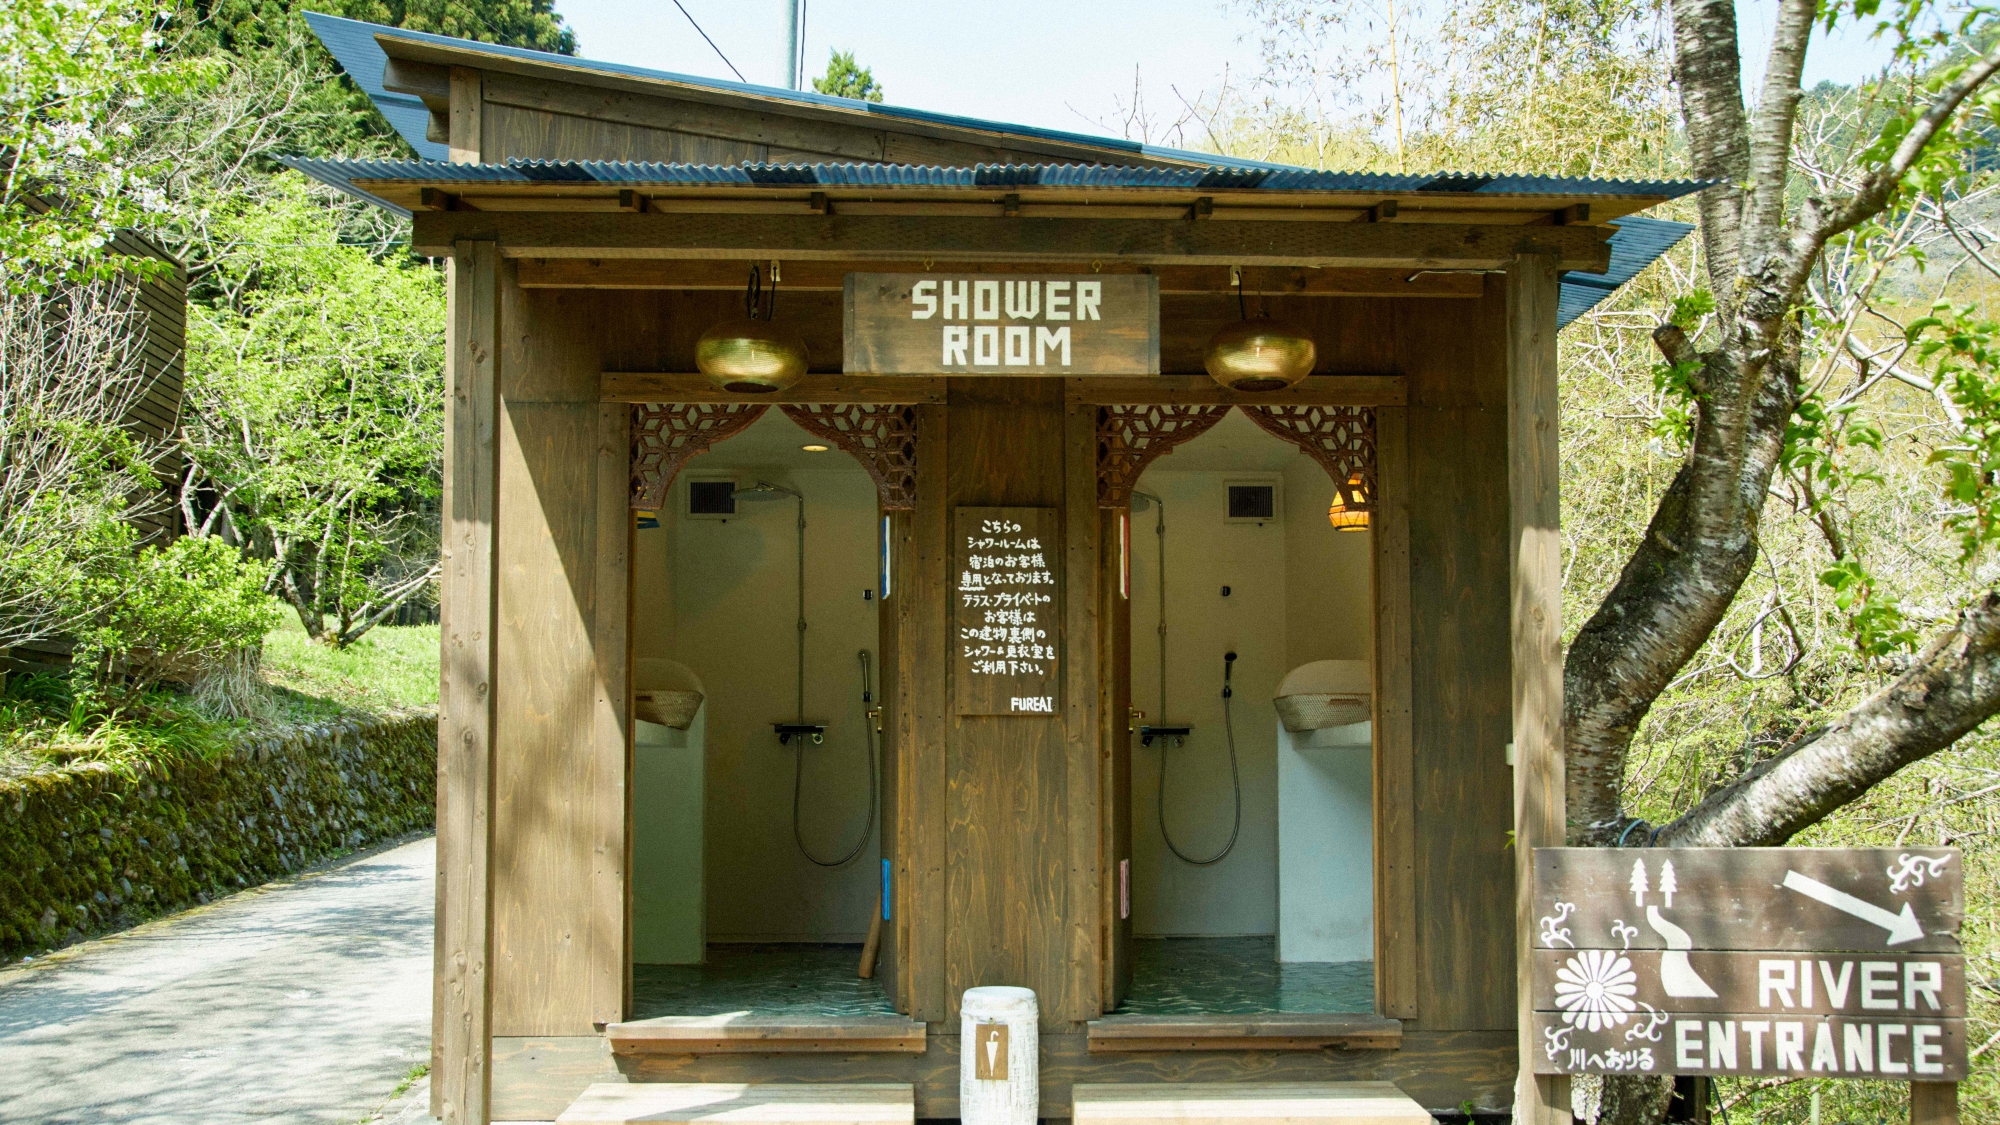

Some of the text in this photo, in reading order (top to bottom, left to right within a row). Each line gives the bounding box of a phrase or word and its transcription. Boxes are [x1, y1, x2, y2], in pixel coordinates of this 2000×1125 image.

[912, 280, 1101, 321] SHOWER
[943, 325, 1071, 366] ROOM
[982, 520, 1021, 533] こちらの
[967, 536, 1041, 549] シャワールームは
[969, 552, 1046, 570] 宿泊のお客様
[960, 570, 1054, 588] 専用となっております。
[984, 609, 1036, 626] お客様は
[961, 625, 1046, 643] この建物裏側の
[971, 660, 1044, 676] ご利用下さい。
[1011, 696, 1053, 712] FUREAI
[1758, 959, 1942, 1010] RIVER
[1675, 1019, 1944, 1075] ENTRANCE
[1567, 1047, 1655, 1071] 川へおりる
